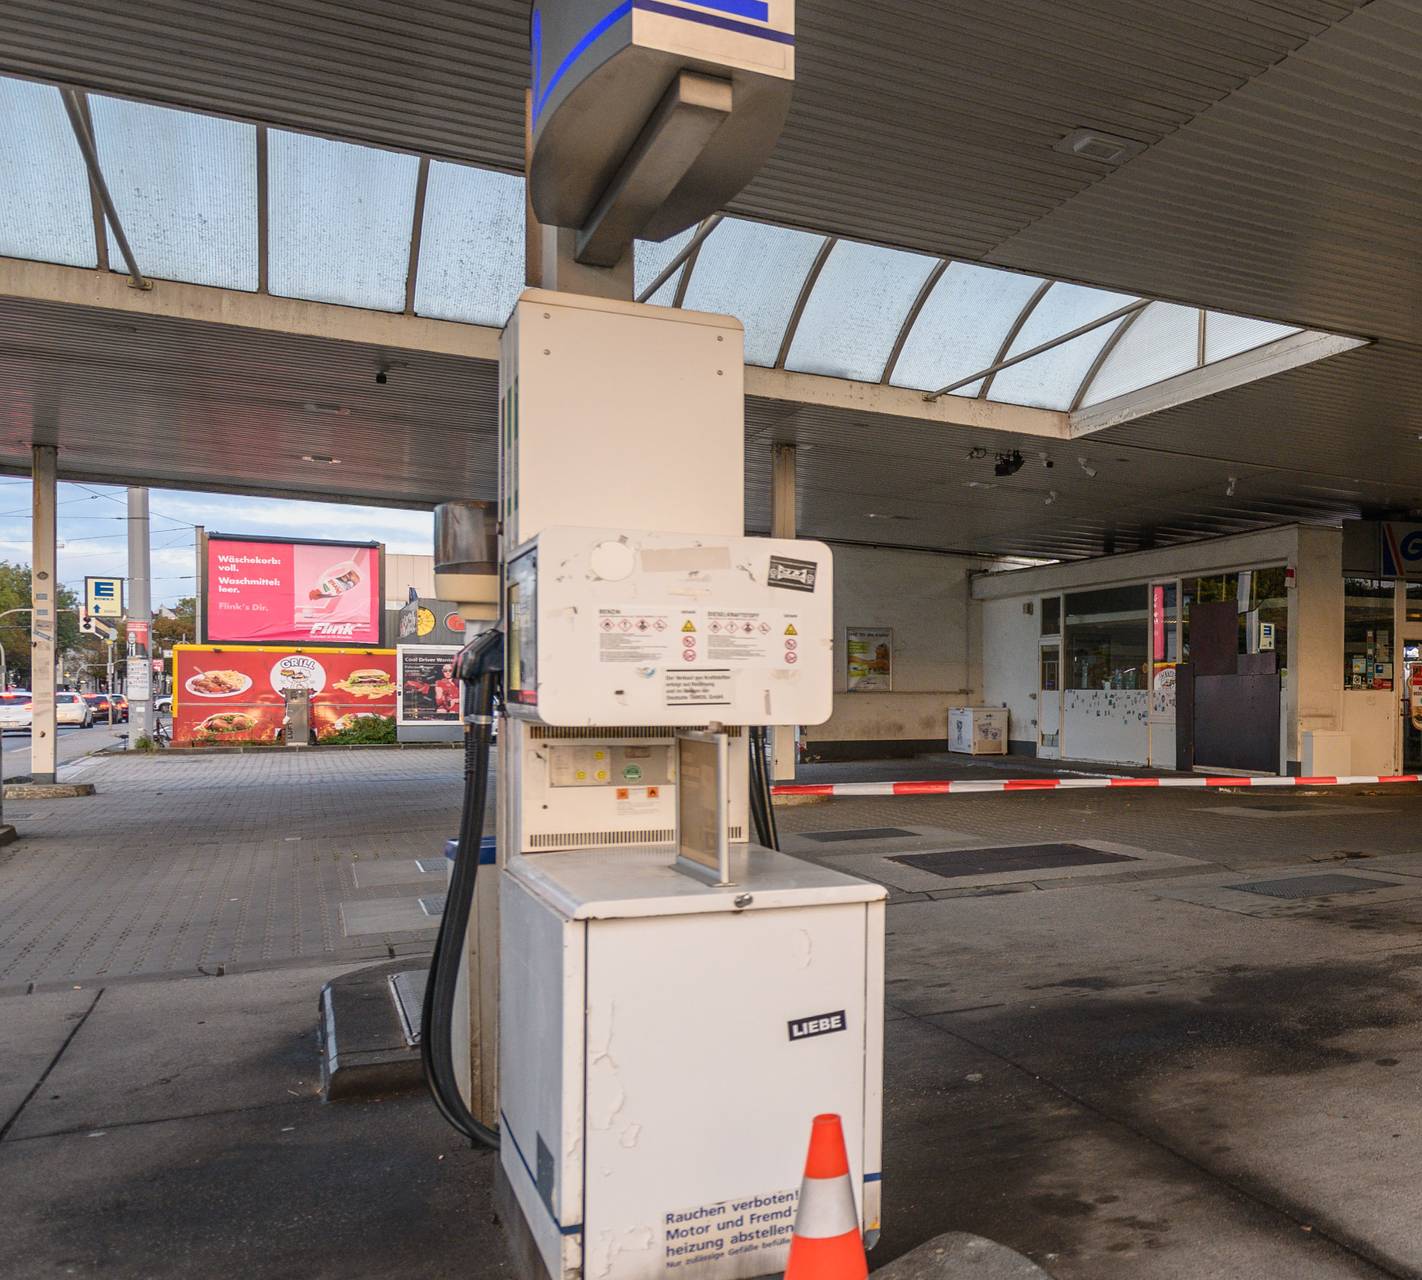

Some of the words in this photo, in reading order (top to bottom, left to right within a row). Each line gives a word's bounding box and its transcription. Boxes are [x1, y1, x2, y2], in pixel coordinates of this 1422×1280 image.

[218, 555, 281, 565] Wäschekorb:
[218, 577, 281, 586] Waschmittel:
[218, 586, 240, 594] leer.
[309, 622, 353, 635] Flink
[281, 658, 316, 670] GRILL
[792, 1015, 842, 1037] LIEBE
[665, 1205, 726, 1225] Rauchen
[732, 1190, 800, 1212] verboten!
[665, 1224, 711, 1241] Motor
[717, 1215, 744, 1231] und
[750, 1206, 798, 1225] Fremd-
[666, 1237, 724, 1257] heizung
[730, 1224, 795, 1245] abstellen
[666, 1260, 682, 1269] Nur
[685, 1252, 724, 1265] zulässige
[728, 1244, 758, 1256] Gefäße
[762, 1237, 792, 1249] befülle
